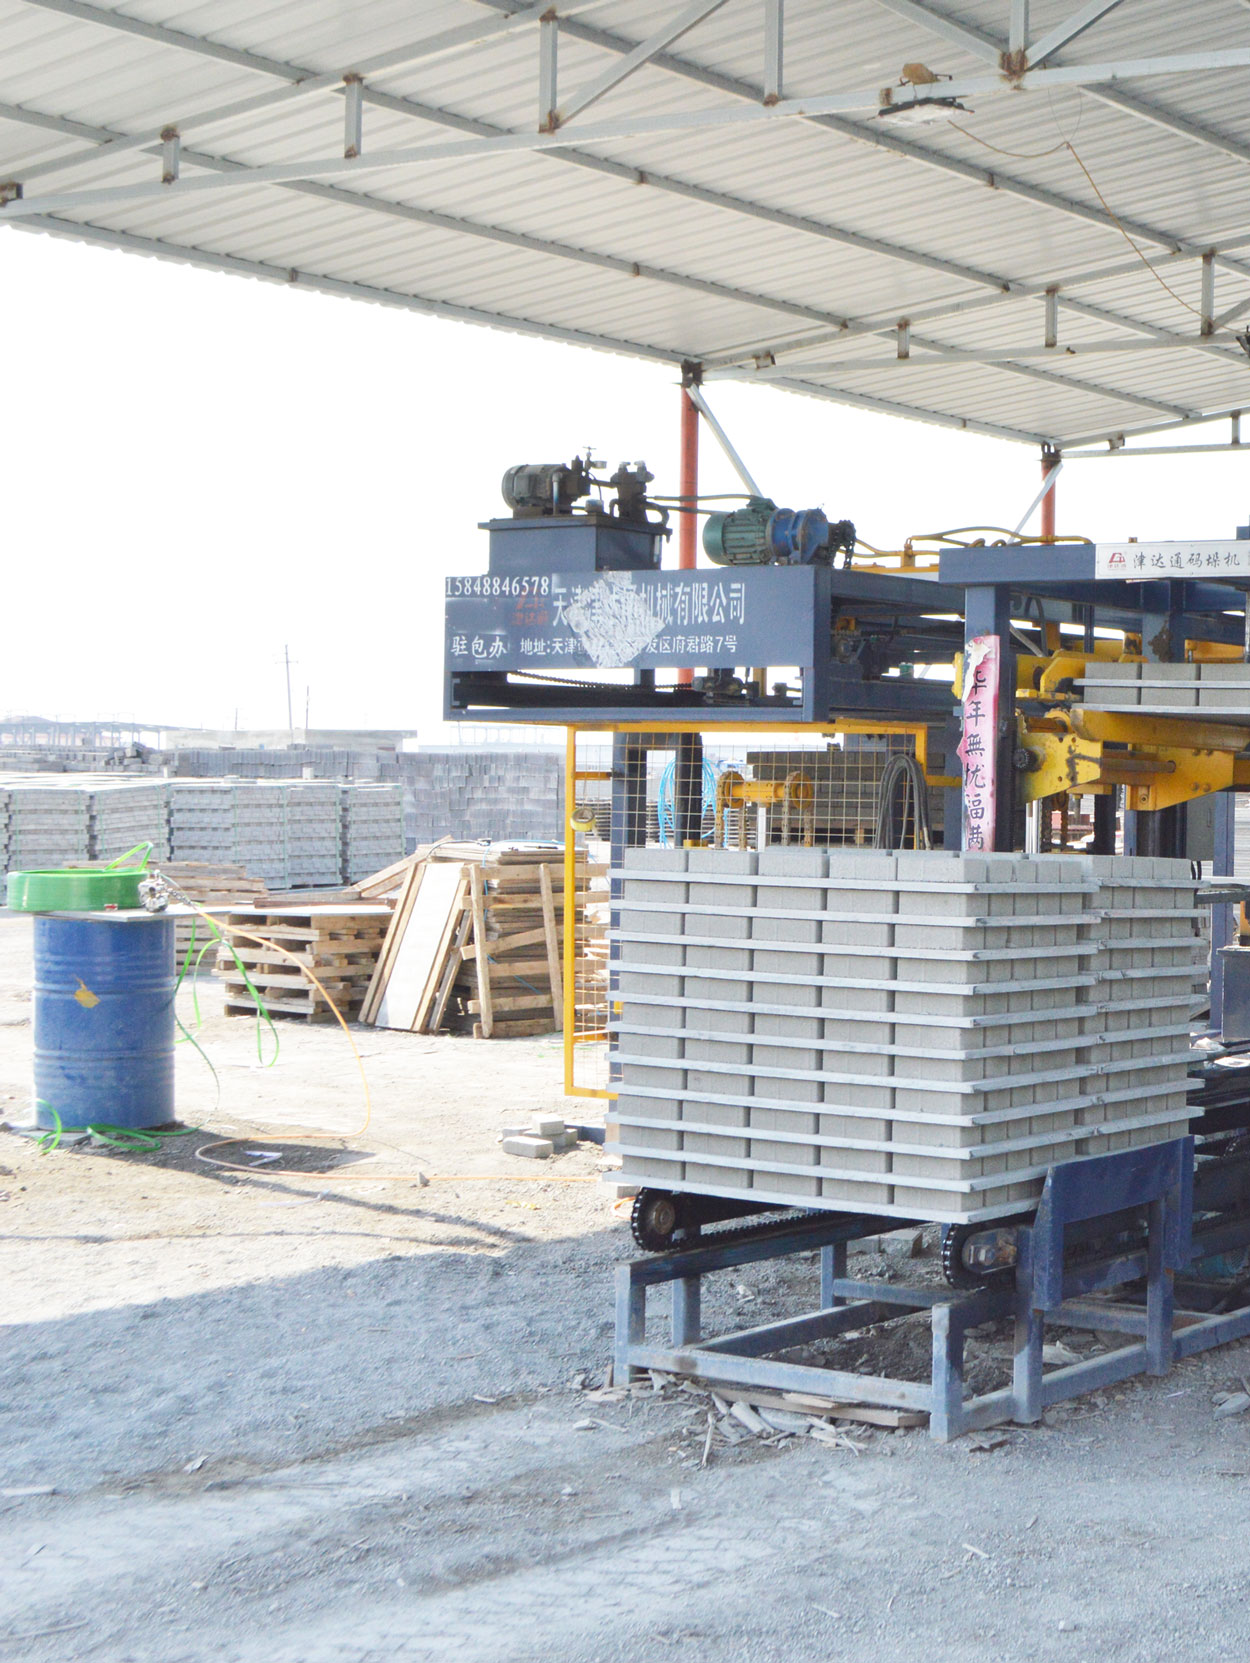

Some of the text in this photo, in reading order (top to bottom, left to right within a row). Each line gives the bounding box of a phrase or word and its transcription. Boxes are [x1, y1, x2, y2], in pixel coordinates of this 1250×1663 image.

[1133, 551, 1241, 570] 津达通码垛机
[445, 576, 550, 596] 15848846578
[450, 635, 508, 658] 驻包办
